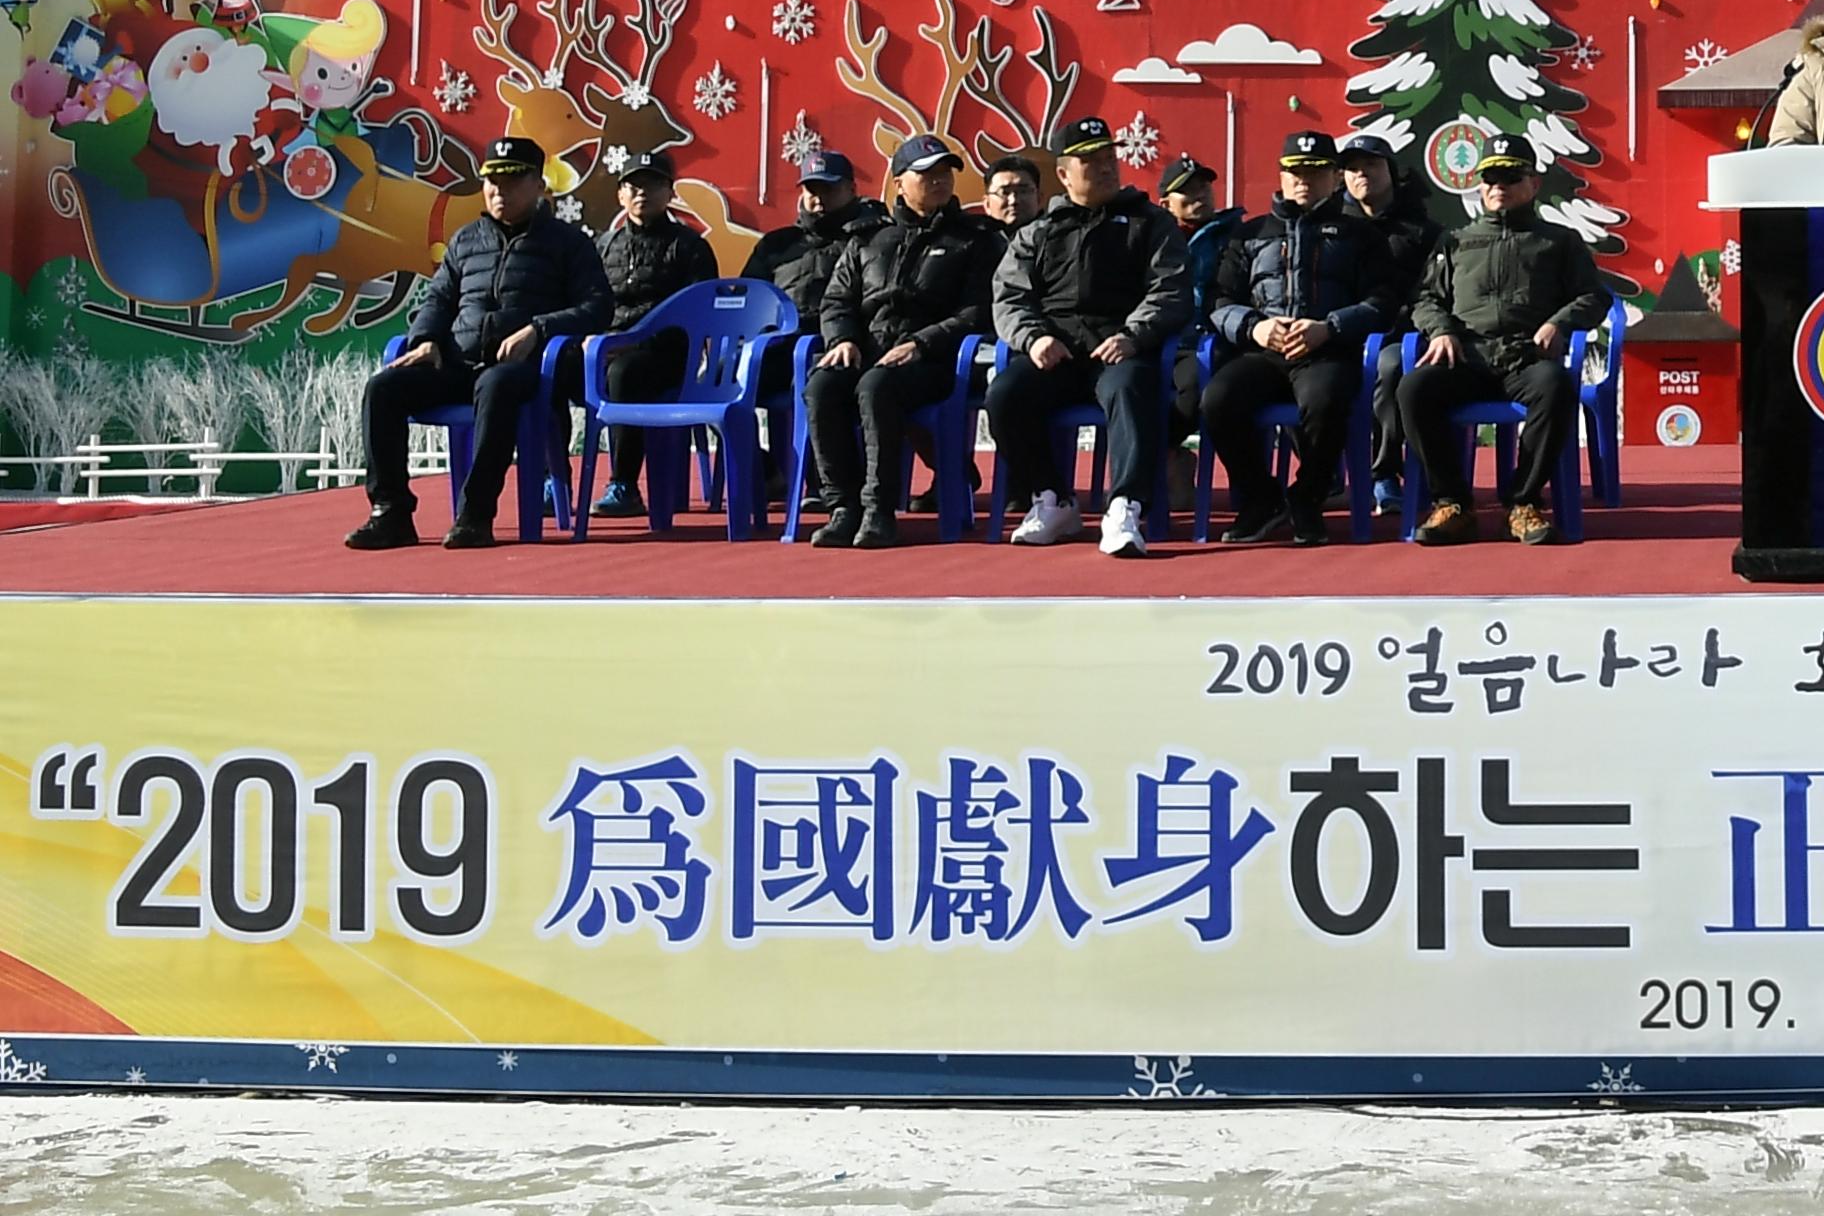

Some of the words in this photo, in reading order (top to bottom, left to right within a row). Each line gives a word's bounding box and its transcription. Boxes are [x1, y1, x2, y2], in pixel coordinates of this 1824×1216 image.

[1659, 371, 1700, 384] POST
[1206, 642, 1351, 696] 2019
[1377, 621, 1743, 714] 얼음나라
[1640, 978, 1796, 1030] 2019.
